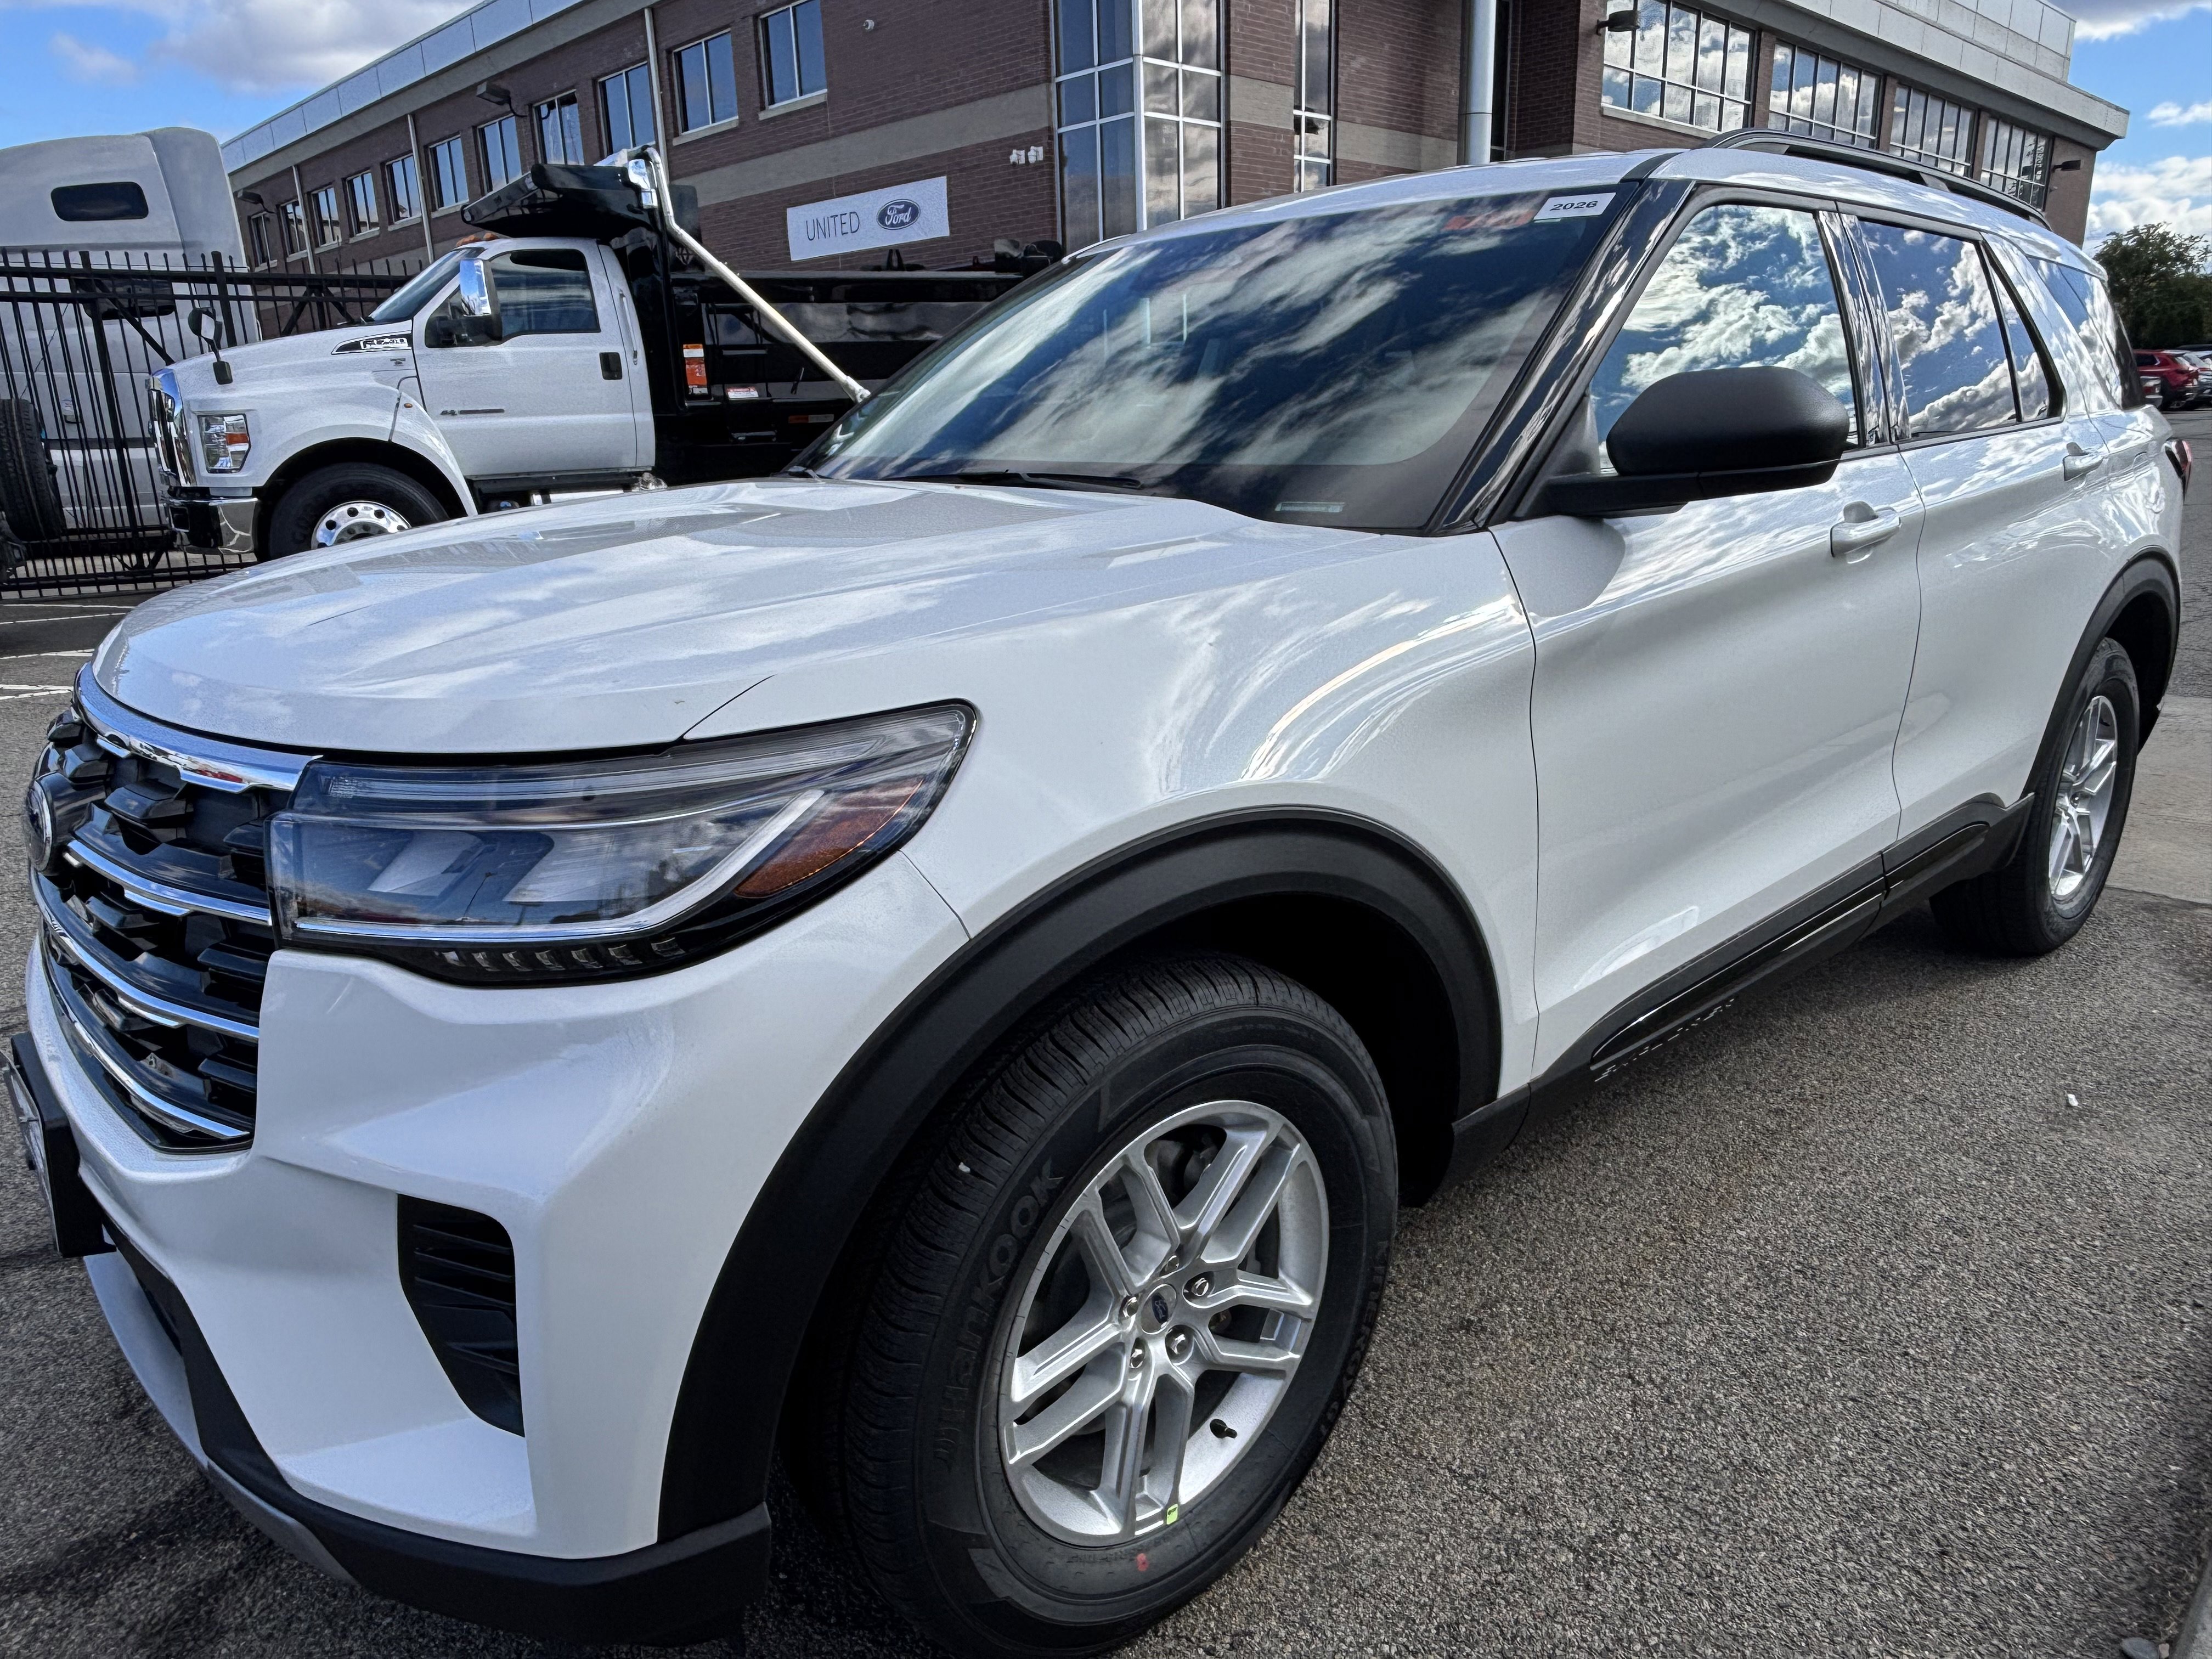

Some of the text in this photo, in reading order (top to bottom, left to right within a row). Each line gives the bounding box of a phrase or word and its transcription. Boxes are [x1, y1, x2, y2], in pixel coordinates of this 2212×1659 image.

[1549, 200, 1599, 212] 2026
[806, 204, 912, 241] UNITED Ford
